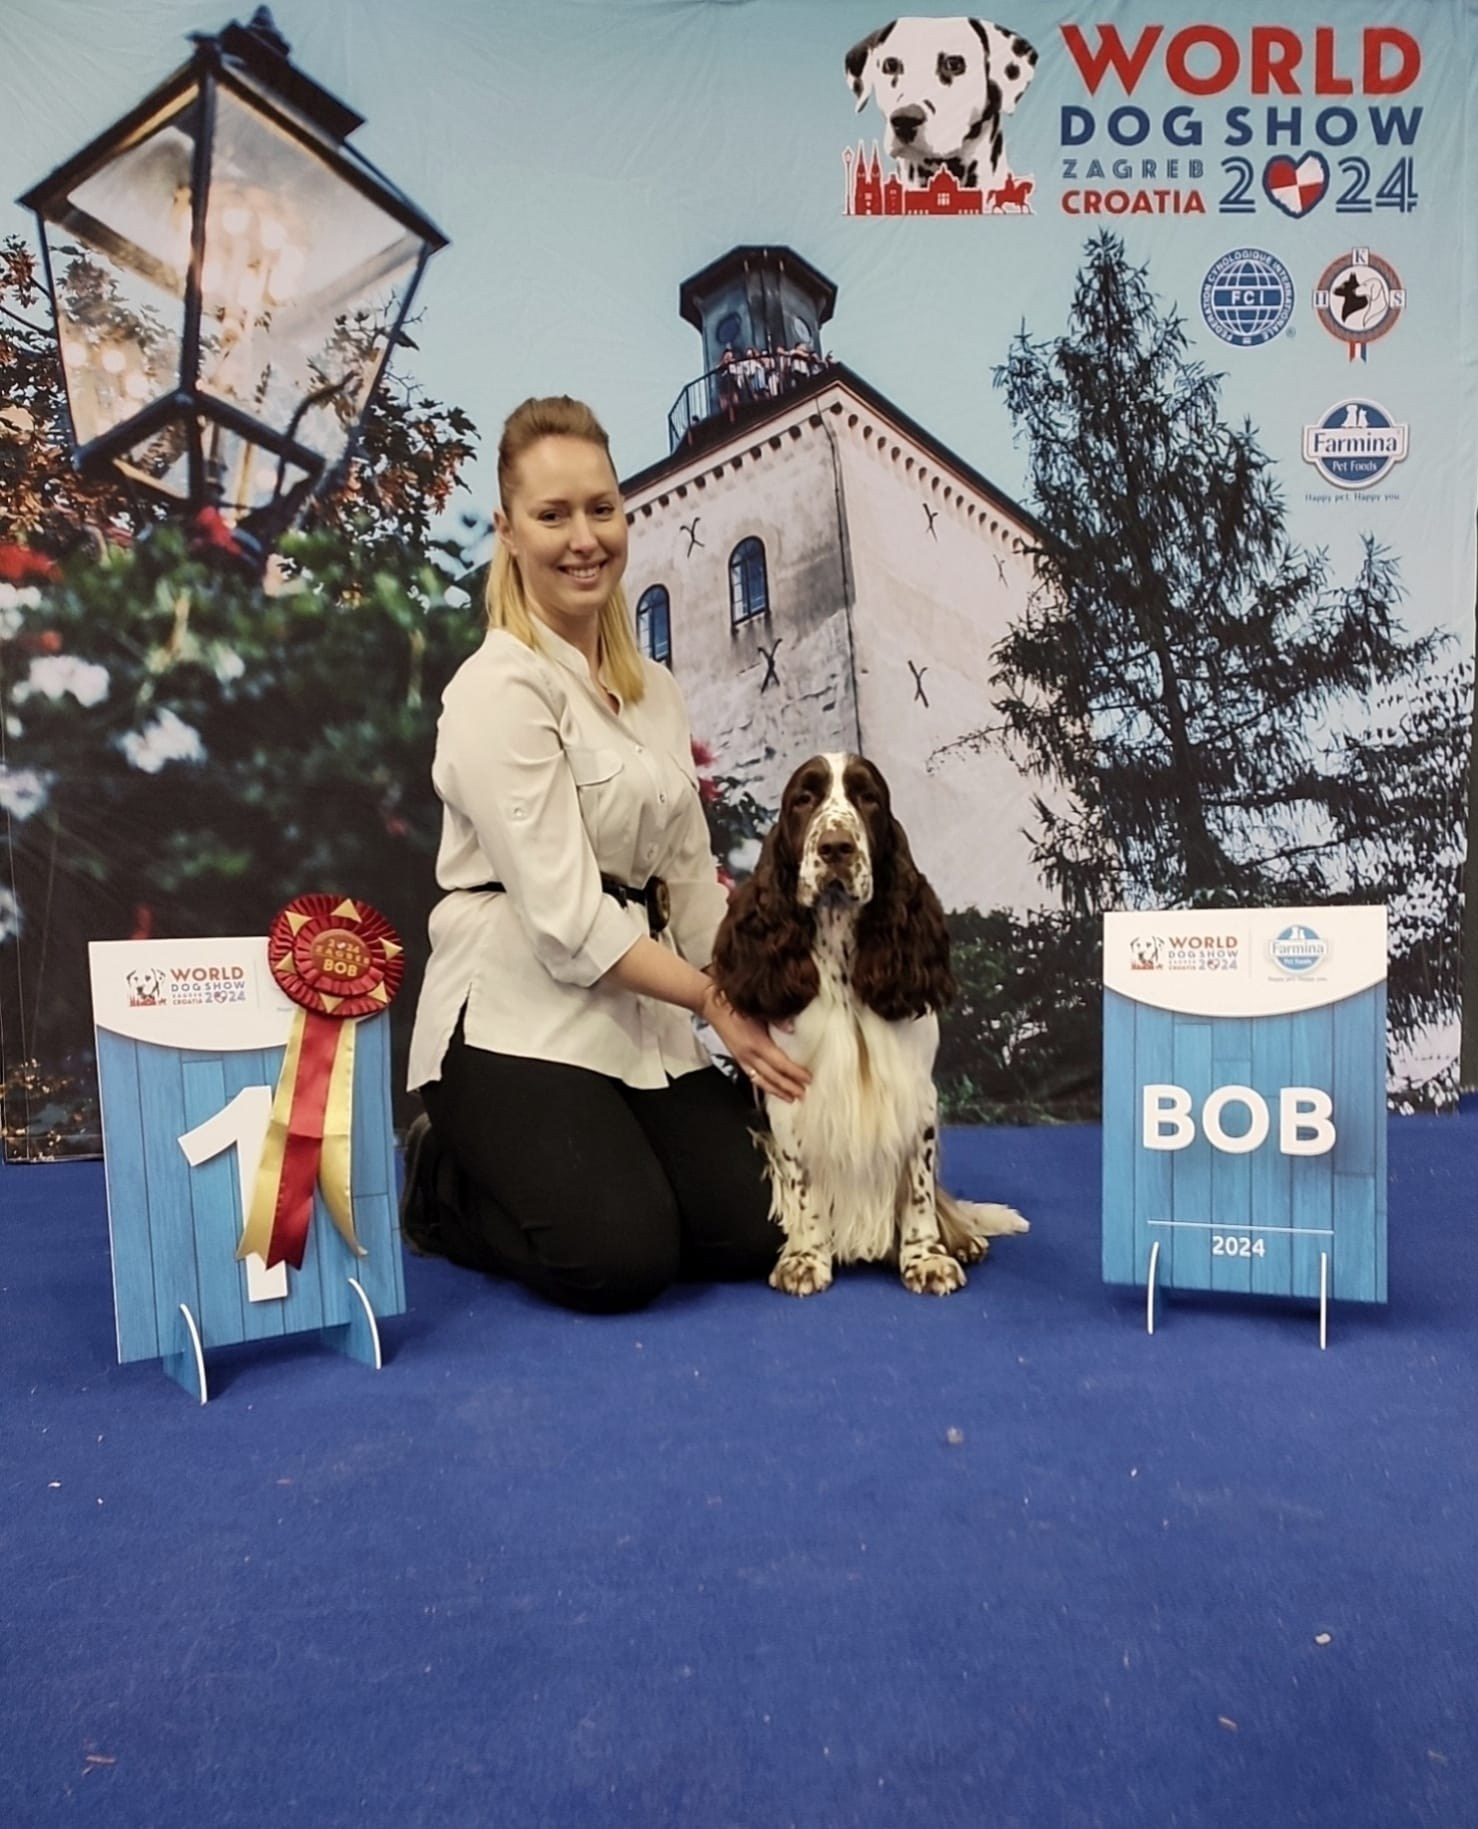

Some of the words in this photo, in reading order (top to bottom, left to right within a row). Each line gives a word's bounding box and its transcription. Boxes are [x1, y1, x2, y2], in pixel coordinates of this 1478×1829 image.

[1059, 24, 1421, 97] WORLD
[1060, 106, 1203, 146] DOG
[1224, 106, 1424, 146] SHOW
[1062, 158, 1204, 179] ZAGREB
[1061, 189, 1206, 215] CROATIA
[1207, 250, 1273, 283] CYNOLOGIQUE
[1231, 289, 1264, 305] FCI
[1313, 432, 1397, 453] Farmina
[1332, 460, 1348, 472] Pet
[1350, 459, 1378, 472] Foods
[1168, 936, 1238, 949] WORLD
[1272, 942, 1325, 954] Farmina
[1168, 950, 1196, 958] DOG
[170, 966, 244, 982] WORLD
[323, 958, 358, 977] BOB
[171, 983, 201, 992] DOG
[205, 981, 245, 991] SHOW
[1143, 1084, 1336, 1156] BOB
[178, 1085, 288, 1302] 1
[1212, 1235, 1265, 1258] 2024
